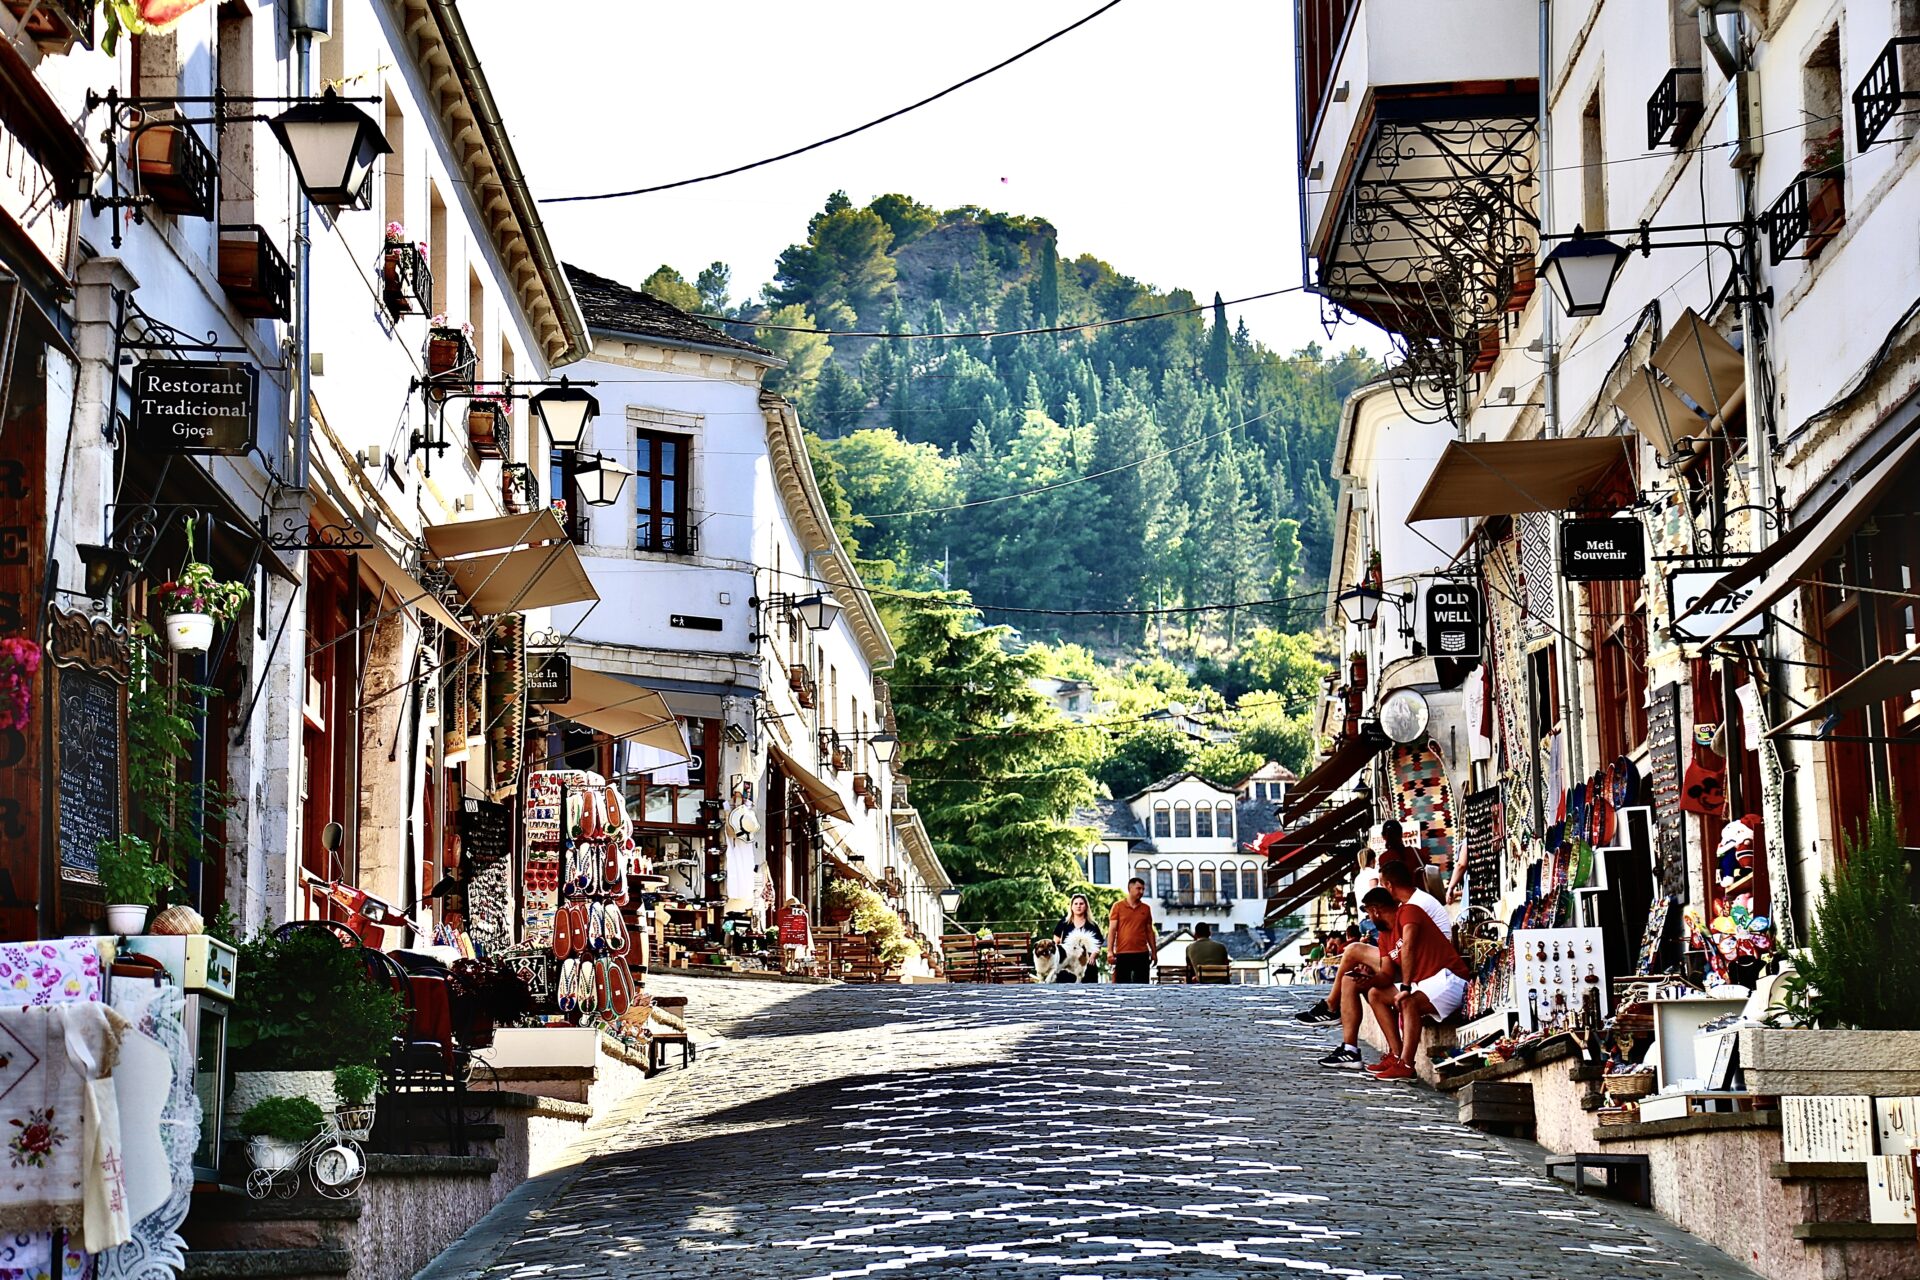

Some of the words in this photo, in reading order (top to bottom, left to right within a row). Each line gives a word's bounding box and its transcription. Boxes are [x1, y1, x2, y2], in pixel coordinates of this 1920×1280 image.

[147, 375, 243, 395] Restorant
[141, 399, 248, 417] Tradicional
[172, 422, 214, 439] Gjoça
[1586, 540, 1614, 550] Meti
[1573, 549, 1628, 560] Souvenir
[1435, 593, 1470, 605] OLD
[1433, 611, 1472, 623] WELL
[527, 669, 544, 678] ade
[546, 669, 558, 678] In
[527, 679, 558, 688] lbania
